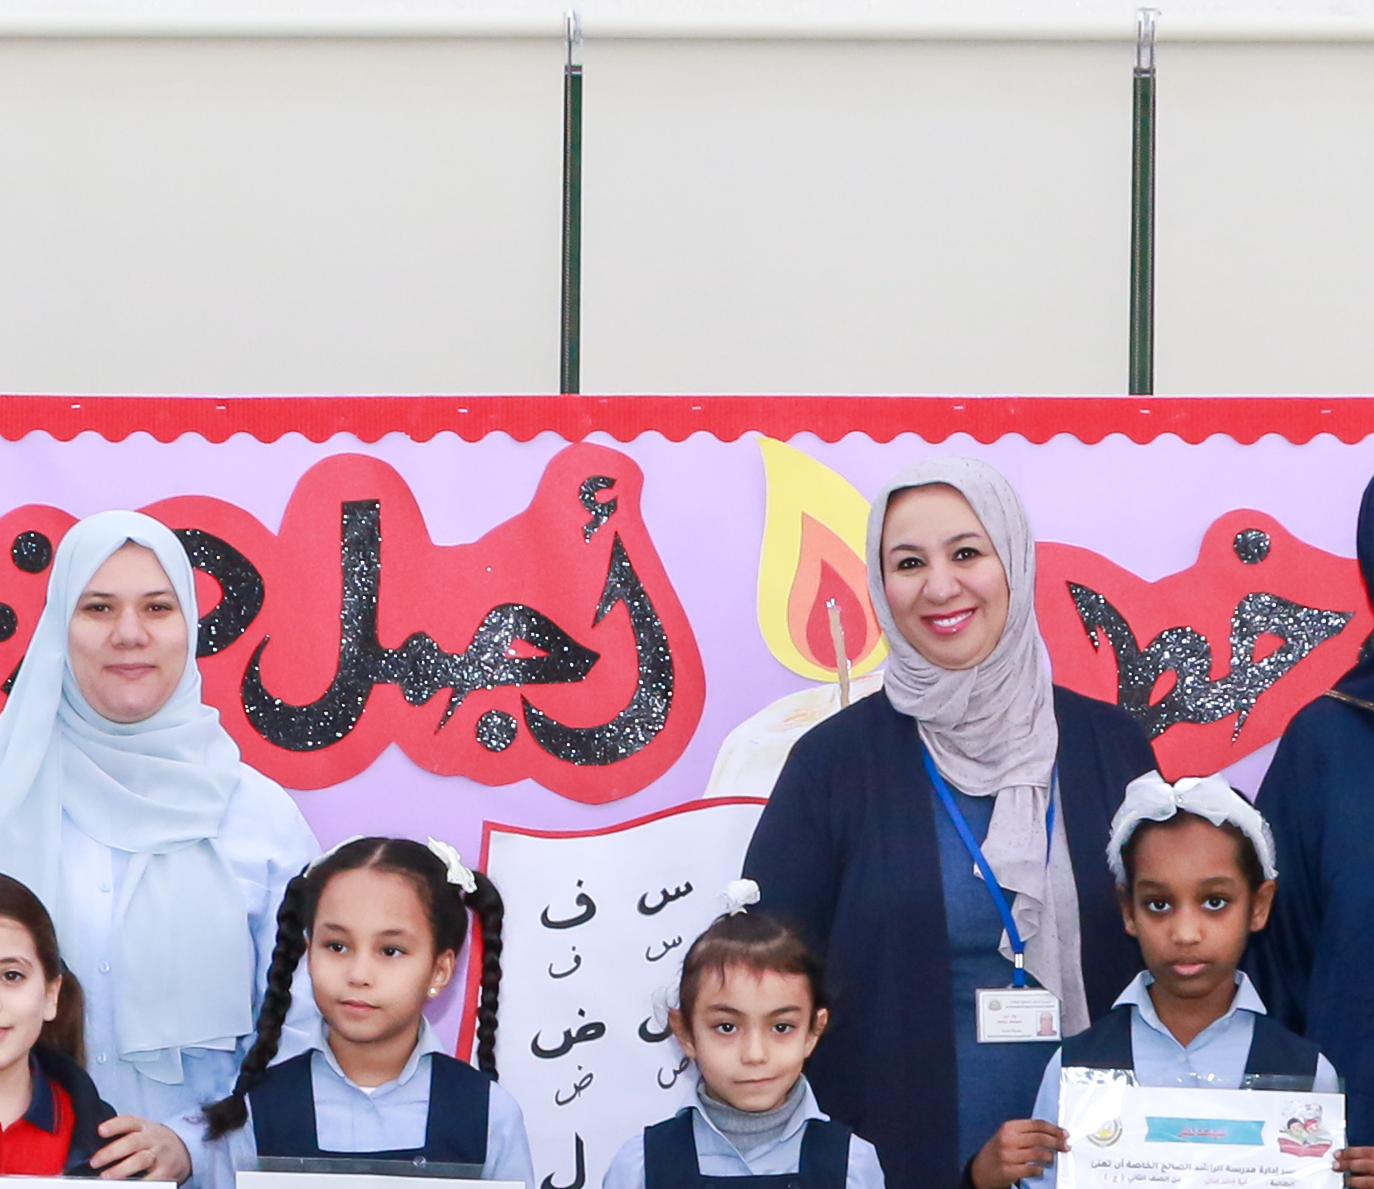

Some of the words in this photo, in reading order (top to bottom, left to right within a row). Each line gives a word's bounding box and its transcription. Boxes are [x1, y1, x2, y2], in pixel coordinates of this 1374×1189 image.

[240, 472, 676, 767] أجمل
[540, 879, 597, 929] ف
[638, 878, 693, 915] س
[548, 946, 581, 979] ف
[645, 934, 682, 961] س
[530, 1008, 606, 1058] ض
[555, 1066, 594, 1105] ض
